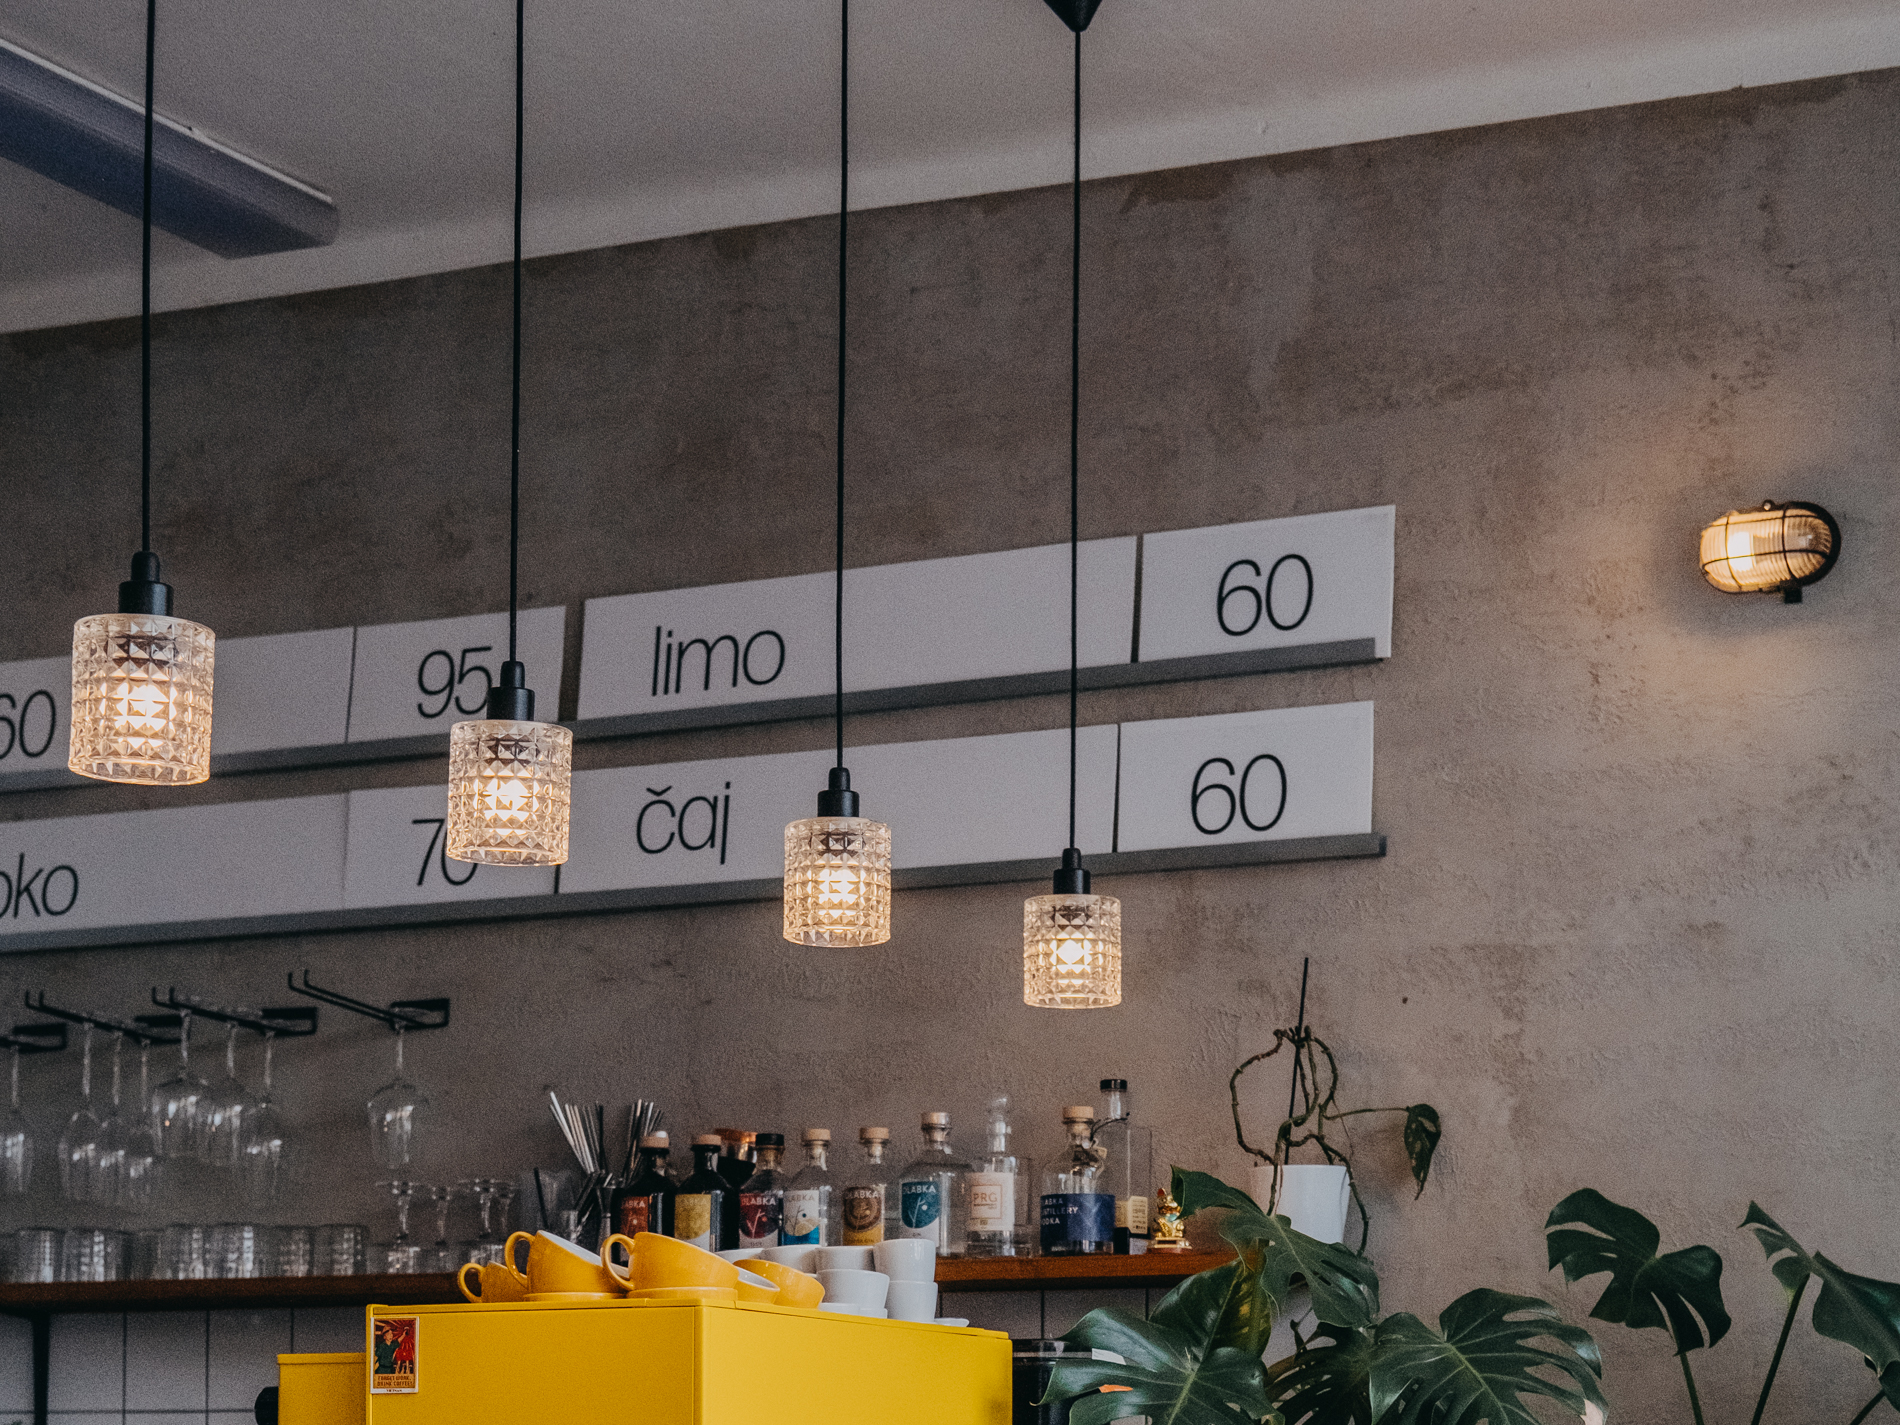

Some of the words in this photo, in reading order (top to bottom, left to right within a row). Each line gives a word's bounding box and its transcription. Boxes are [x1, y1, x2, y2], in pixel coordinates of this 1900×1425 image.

[1216, 554, 1314, 636] 60
[418, 646, 493, 719] 95
[651, 625, 785, 697] limo
[637, 781, 731, 866] čaj
[1191, 754, 1287, 835] 60
[973, 1192, 998, 1203] PRG
